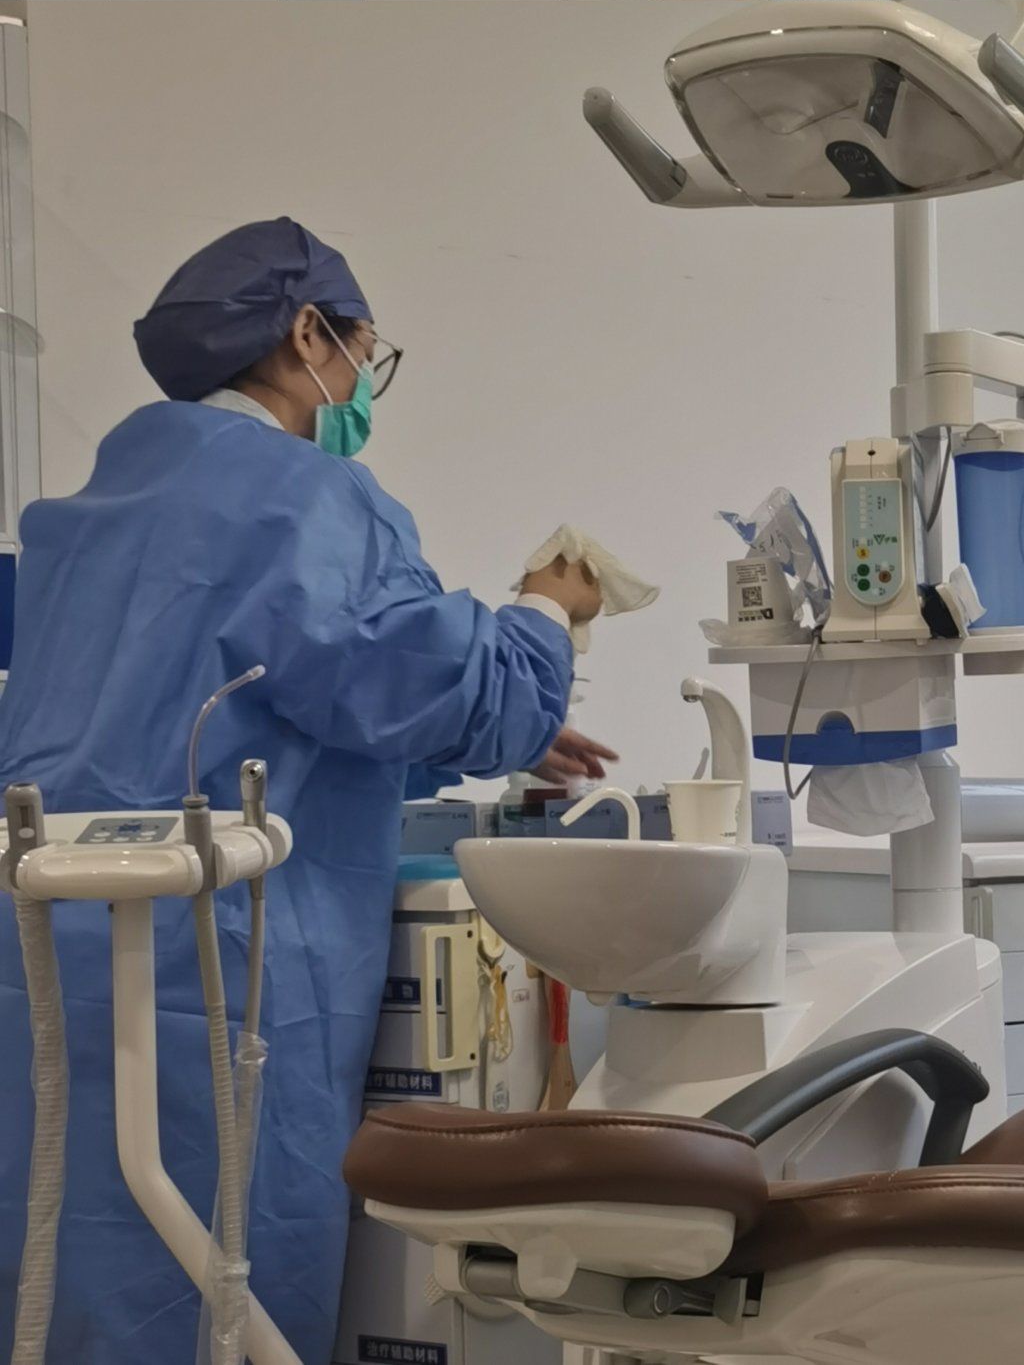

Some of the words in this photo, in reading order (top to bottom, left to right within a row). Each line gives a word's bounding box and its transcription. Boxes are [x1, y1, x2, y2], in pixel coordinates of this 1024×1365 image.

[368, 1072, 433, 1090] 疗辅助材料
